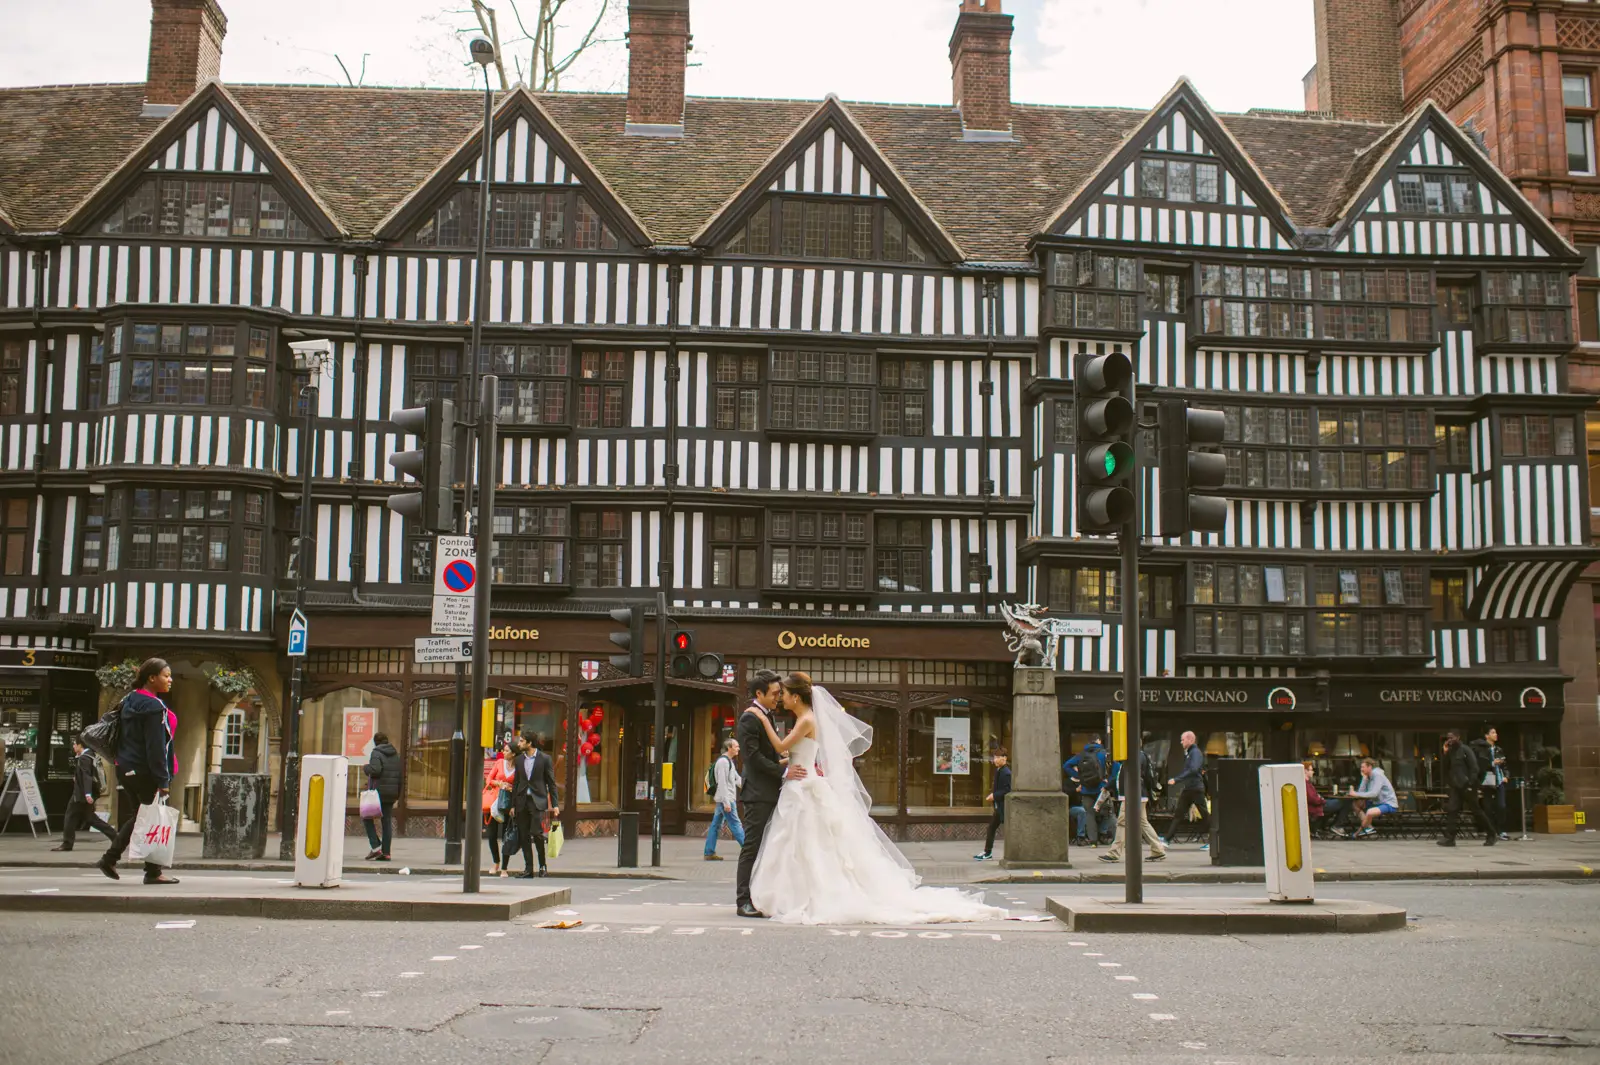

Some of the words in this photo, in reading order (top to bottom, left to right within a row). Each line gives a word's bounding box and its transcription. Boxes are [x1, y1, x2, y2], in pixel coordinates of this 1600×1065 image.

[440, 538, 475, 546] Controll
[444, 548, 476, 557] ZONE
[488, 625, 540, 640] dafone
[291, 631, 302, 651] P
[797, 633, 871, 649] vodafone
[417, 646, 461, 654] enforcement
[21, 649, 36, 666] 3
[1113, 689, 1161, 702] CFE'
[1165, 690, 1248, 703] VERGNANO
[1426, 690, 1502, 702] VERGNANO
